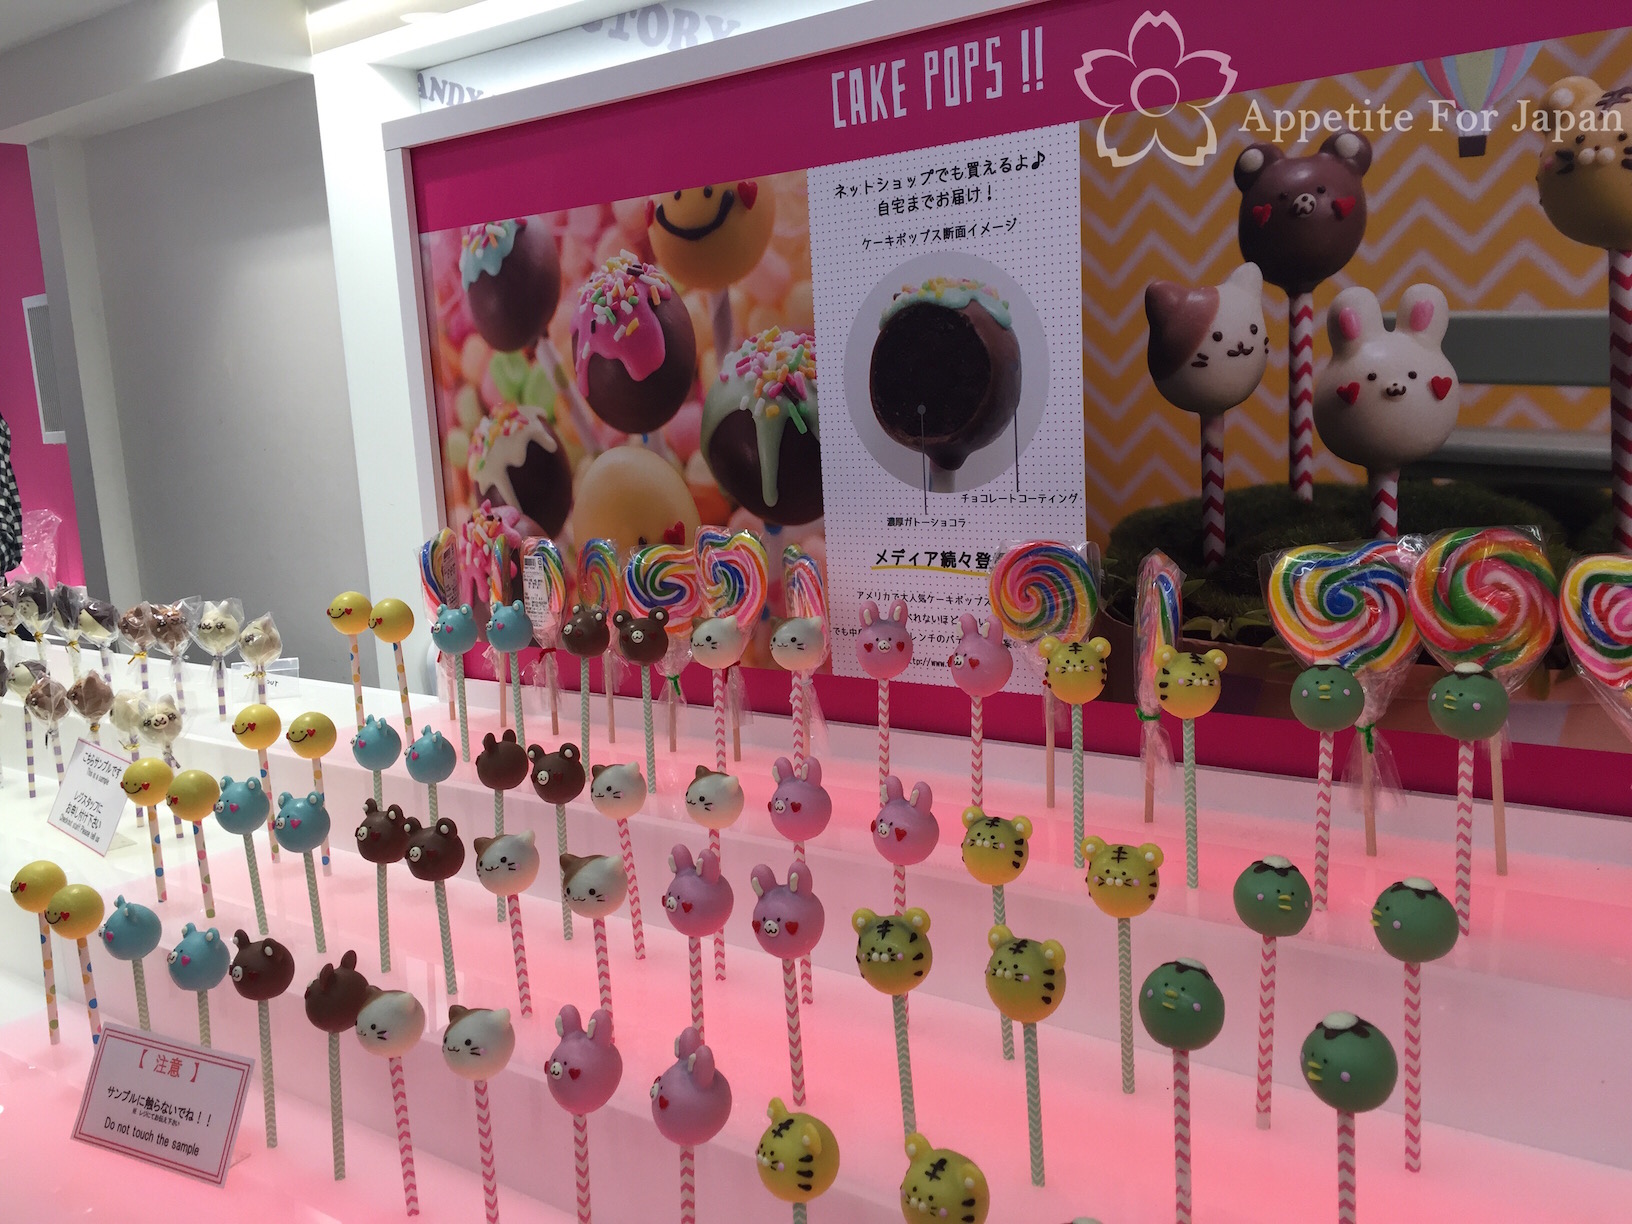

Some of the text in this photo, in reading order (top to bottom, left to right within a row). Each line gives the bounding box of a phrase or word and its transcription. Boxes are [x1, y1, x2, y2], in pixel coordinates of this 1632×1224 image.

[831, 59, 907, 128] CAKE
[924, 35, 1002, 110] POPS
[878, 185, 992, 216] 自宅までお届け！
[862, 218, 1017, 250] ケーキポップス断面イメージ
[961, 493, 1078, 504] チョコレートコーティング
[887, 517, 966, 528] 濃厚ガトーショコラ
[104, 1116, 199, 1157] Do not touch the sample
